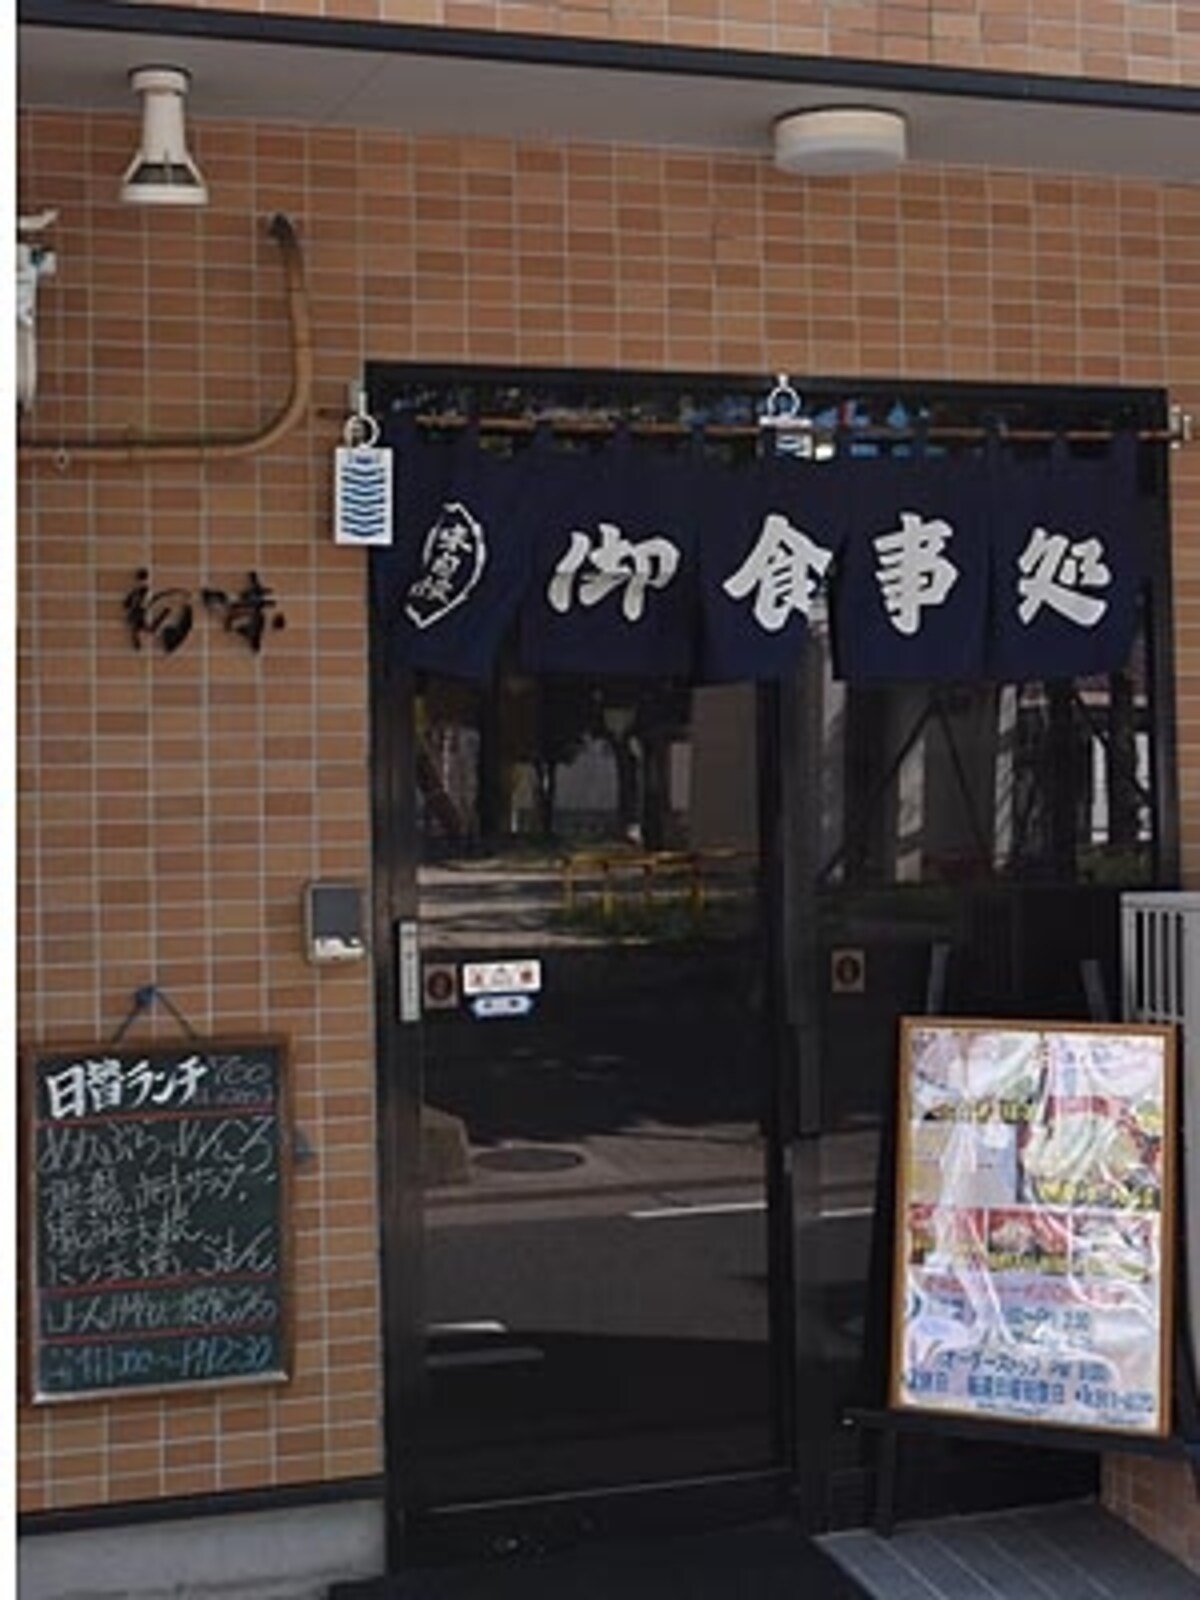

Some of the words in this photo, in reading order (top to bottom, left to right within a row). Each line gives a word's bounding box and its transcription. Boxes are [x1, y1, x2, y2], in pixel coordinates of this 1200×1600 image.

[547, 513, 1112, 635] 御食事処
[46, 1055, 208, 1119] 日替ランチ
